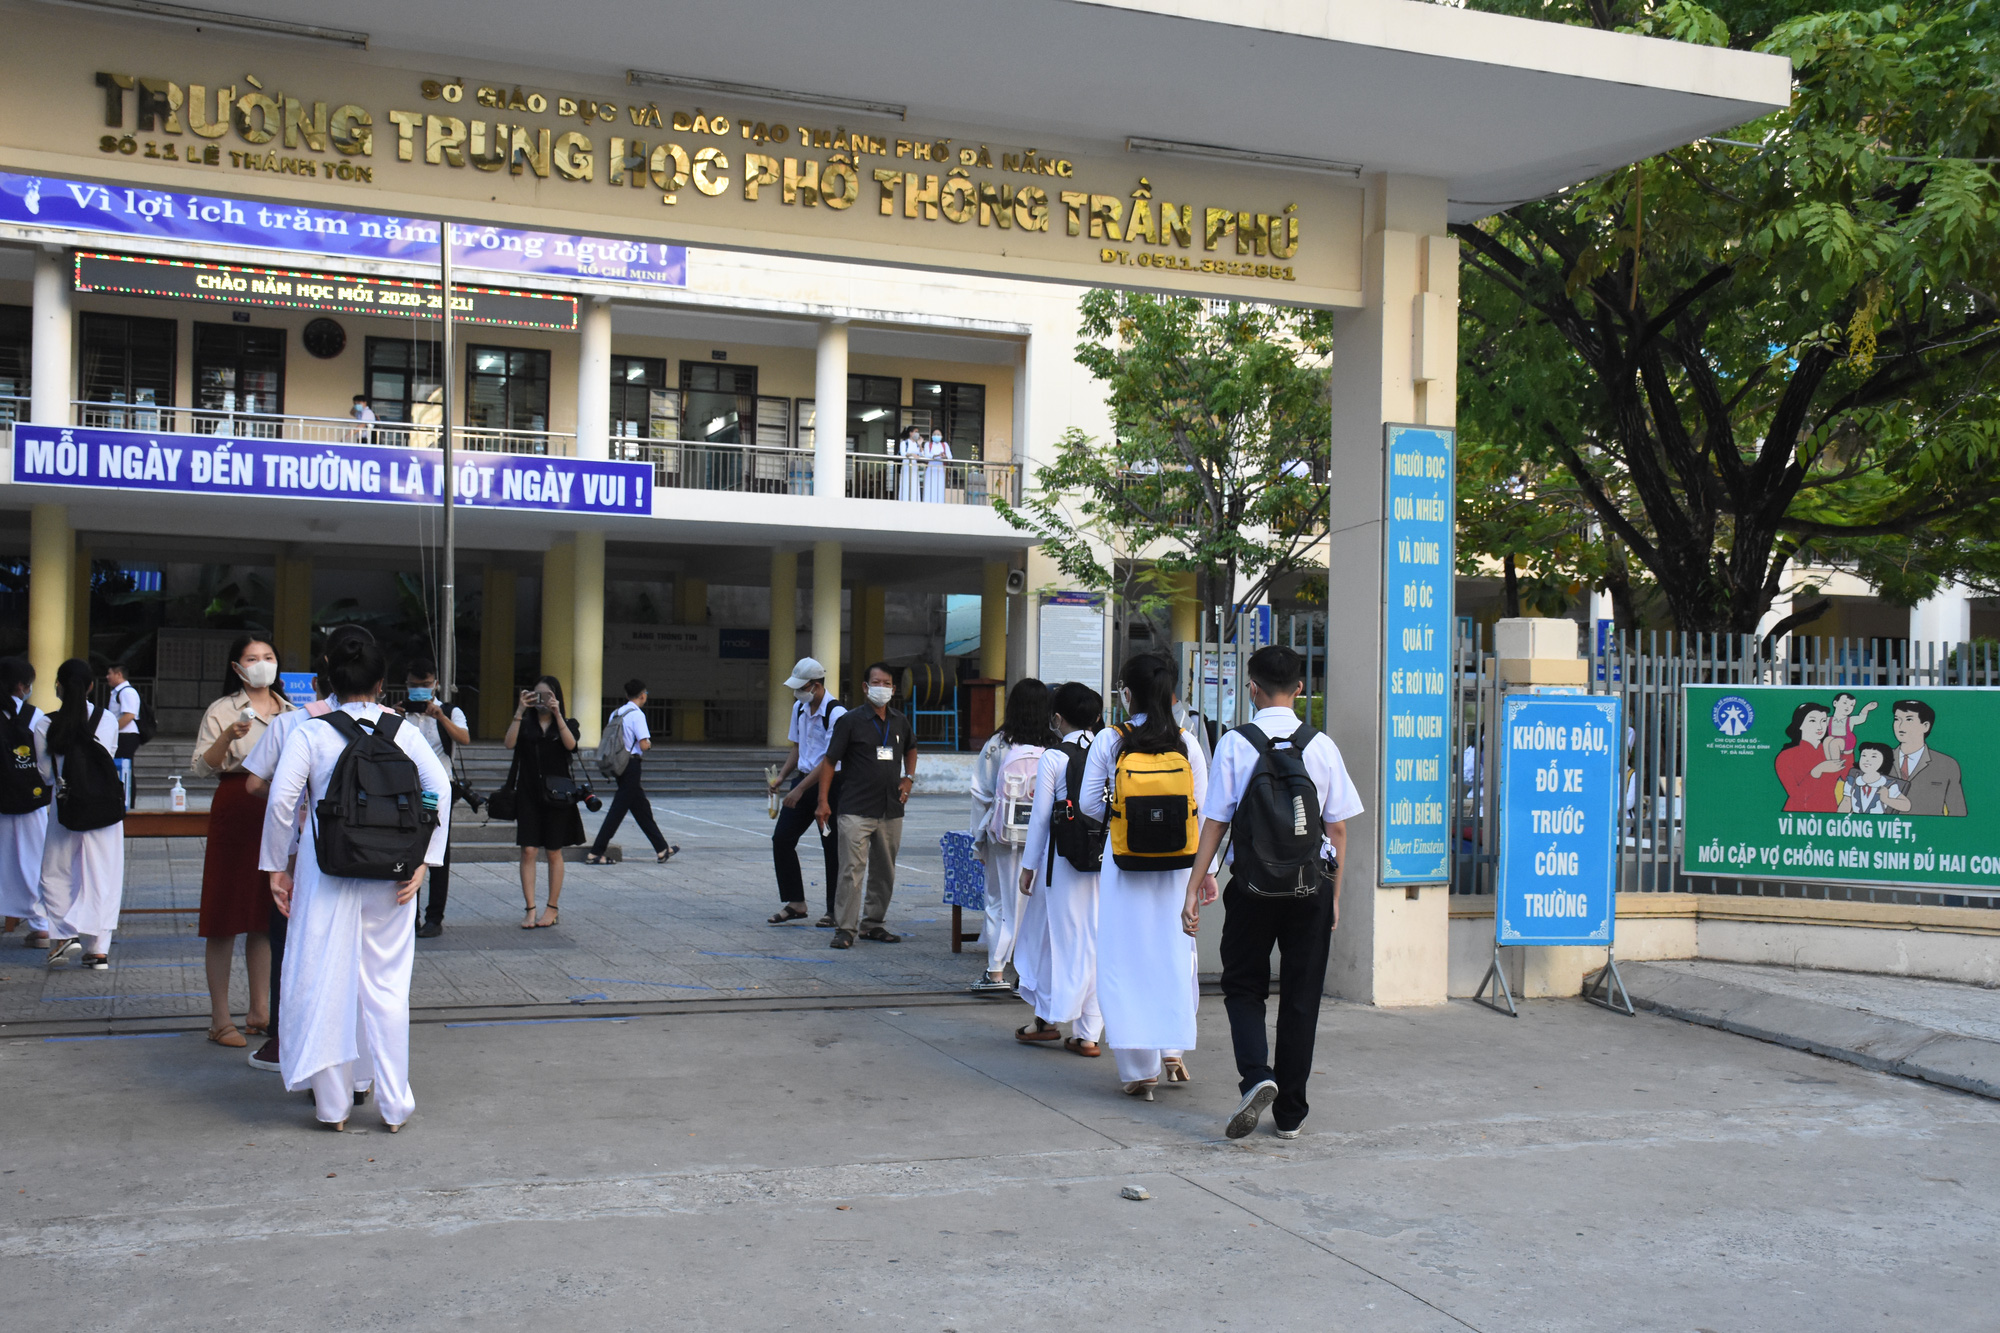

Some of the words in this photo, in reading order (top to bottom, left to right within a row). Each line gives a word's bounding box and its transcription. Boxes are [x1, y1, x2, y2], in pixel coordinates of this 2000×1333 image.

[421, 77, 465, 103] SỞ
[477, 85, 548, 114] GIÁO
[559, 98, 618, 126] DỤC
[629, 104, 663, 129] VÀ
[673, 108, 731, 136] ĐÀO
[738, 119, 790, 147] TẠO
[798, 126, 887, 156] THÀNH
[896, 138, 952, 163] PHỐ
[960, 145, 994, 169] ĐÀ
[96, 72, 374, 157] TRƯỜNG
[389, 110, 595, 182] TRUNG
[608, 136, 731, 206] HỌC
[744, 152, 860, 211] PHỔ
[874, 166, 1050, 232] THÔNG
[1060, 177, 1193, 249] TRẦN
[1205, 203, 1300, 260] PHÚ
[144, 141, 180, 162] 11
[187, 143, 221, 166] LÊ
[229, 150, 318, 178] THÁNH
[323, 160, 374, 184] TÔN
[66, 183, 112, 211] Vì
[124, 189, 175, 223] lợi
[187, 199, 246, 226] ích
[257, 206, 349, 235] trăm
[360, 217, 439, 245] năm
[555, 240, 650, 266] người
[660, 244, 669, 266] !
[601, 265, 628, 277] CHÍ
[630, 268, 668, 281] MINH
[195, 272, 248, 292] CHÀO
[297, 283, 335, 300] HỌC
[379, 290, 474, 311] 2020-221!
[24, 429, 88, 477] MỖI
[99, 440, 183, 483] NGÀY
[191, 441, 253, 487] ĐẾN
[262, 450, 381, 493] TRƯỜNG
[389, 456, 425, 496] LÀ
[433, 460, 495, 505] MỘT
[502, 465, 576, 504] NGÀY
[583, 474, 626, 507] VUI
[635, 477, 643, 507] !
[1395, 449, 1424, 477] NGƯỜI
[1425, 456, 1446, 483] ĐỌC
[1394, 493, 1414, 521] QUÁ
[1416, 491, 1445, 522] NHIỀU
[1398, 536, 1412, 564] VÀ
[1413, 537, 1440, 565] DÙNG
[1404, 580, 1418, 612] BỘ
[1419, 580, 1433, 608] ÓC
[1402, 624, 1422, 652] QUÁ
[1424, 624, 1434, 651] ÍT
[1391, 668, 1404, 694] SẼ
[1406, 669, 1423, 694] RƠI
[1425, 668, 1444, 695] VÀO
[1392, 710, 1415, 738] THÓI
[1417, 715, 1443, 740] QUEN
[1513, 720, 1567, 751] KHÔNG
[1570, 722, 1609, 756] ĐẬU,
[1395, 759, 1414, 782] SUY
[1416, 755, 1439, 782] NGHĨ
[1535, 760, 1559, 793] ĐỖ
[1563, 769, 1583, 793] XE
[1390, 798, 1412, 825] LƯỜI
[1415, 795, 1443, 825] BIẾNG
[1531, 805, 1585, 835] TRƯỚC
[1778, 814, 1793, 835] VÌ
[1797, 814, 1822, 836] NÒI
[1826, 811, 1873, 838] GIỐNG
[1877, 817, 1917, 843] VIỆT,
[1387, 838, 1412, 855] Albert
[1413, 838, 1444, 855] Einstein
[1534, 842, 1578, 876] CỔNG
[1699, 838, 1724, 863] MỖI
[1728, 843, 1756, 868] CẶP
[1760, 844, 1780, 870] VỢ
[1783, 841, 1835, 868] CHỒNG
[1838, 846, 1870, 868] NÊN
[1873, 851, 1910, 870] SINH
[1913, 847, 1935, 871] ĐỦ
[1939, 854, 1966, 873] HAI
[1970, 855, 2000, 874] CON
[1524, 888, 1588, 918] TRƯỜNG
